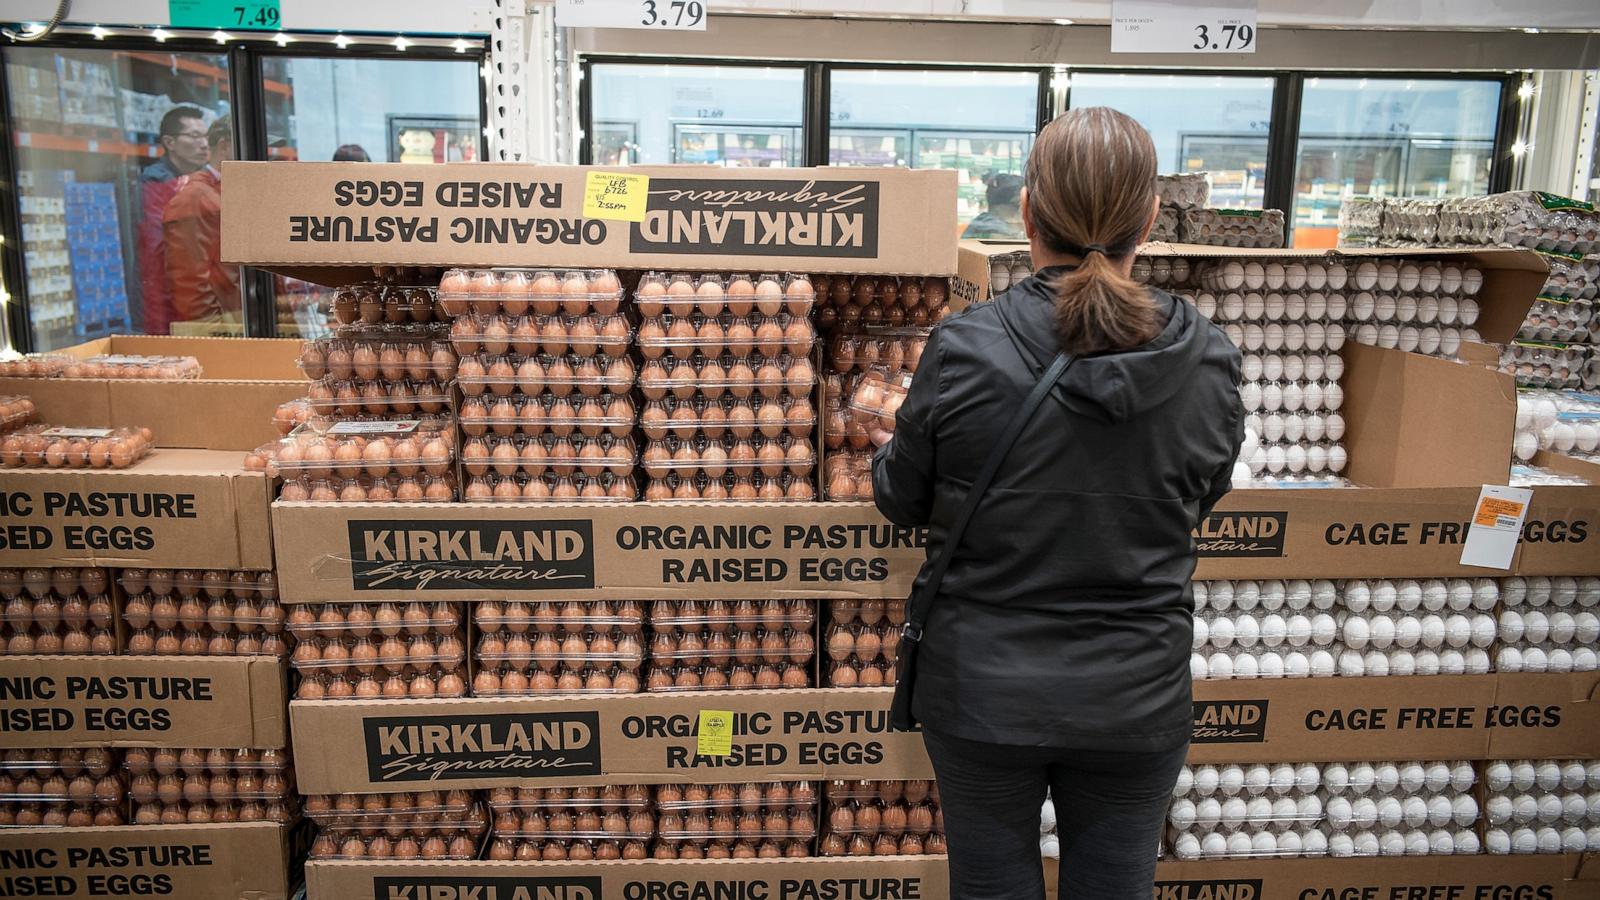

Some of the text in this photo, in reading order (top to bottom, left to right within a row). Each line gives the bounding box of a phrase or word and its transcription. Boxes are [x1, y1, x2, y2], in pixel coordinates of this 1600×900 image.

[233, 7, 280, 26] 7.49
[641, 0, 703, 26] 3.79
[1193, 24, 1253, 49] 3.79
[335, 181, 562, 208] RAISED EGGS
[290, 216, 607, 245] ORGANIC PASTURE
[640, 209, 864, 247] KIRKLAND
[44, 492, 197, 518] PASTURE
[63, 526, 155, 551] EGGS
[363, 530, 584, 561] KIRKLAND
[616, 524, 926, 550] ORGANIC PASTURE
[1325, 523, 1410, 546] CAGE
[1517, 520, 1588, 545] GGS
[367, 562, 586, 591] Signature
[663, 557, 888, 583] RAISED EGGS
[66, 677, 213, 700] PASTURE
[0, 708, 172, 732] ISED EGGS
[621, 710, 922, 739] ORGIC PASTU
[1305, 705, 1561, 731] CAGE FREE EGGS
[378, 721, 591, 755] KIRKLAND
[382, 753, 593, 780] Signature
[799, 742, 884, 766] EGGS
[0, 845, 213, 869] NIC PASTURE
[86, 874, 173, 896] EGGS
[622, 878, 920, 900] ORGANIC PASTURE
